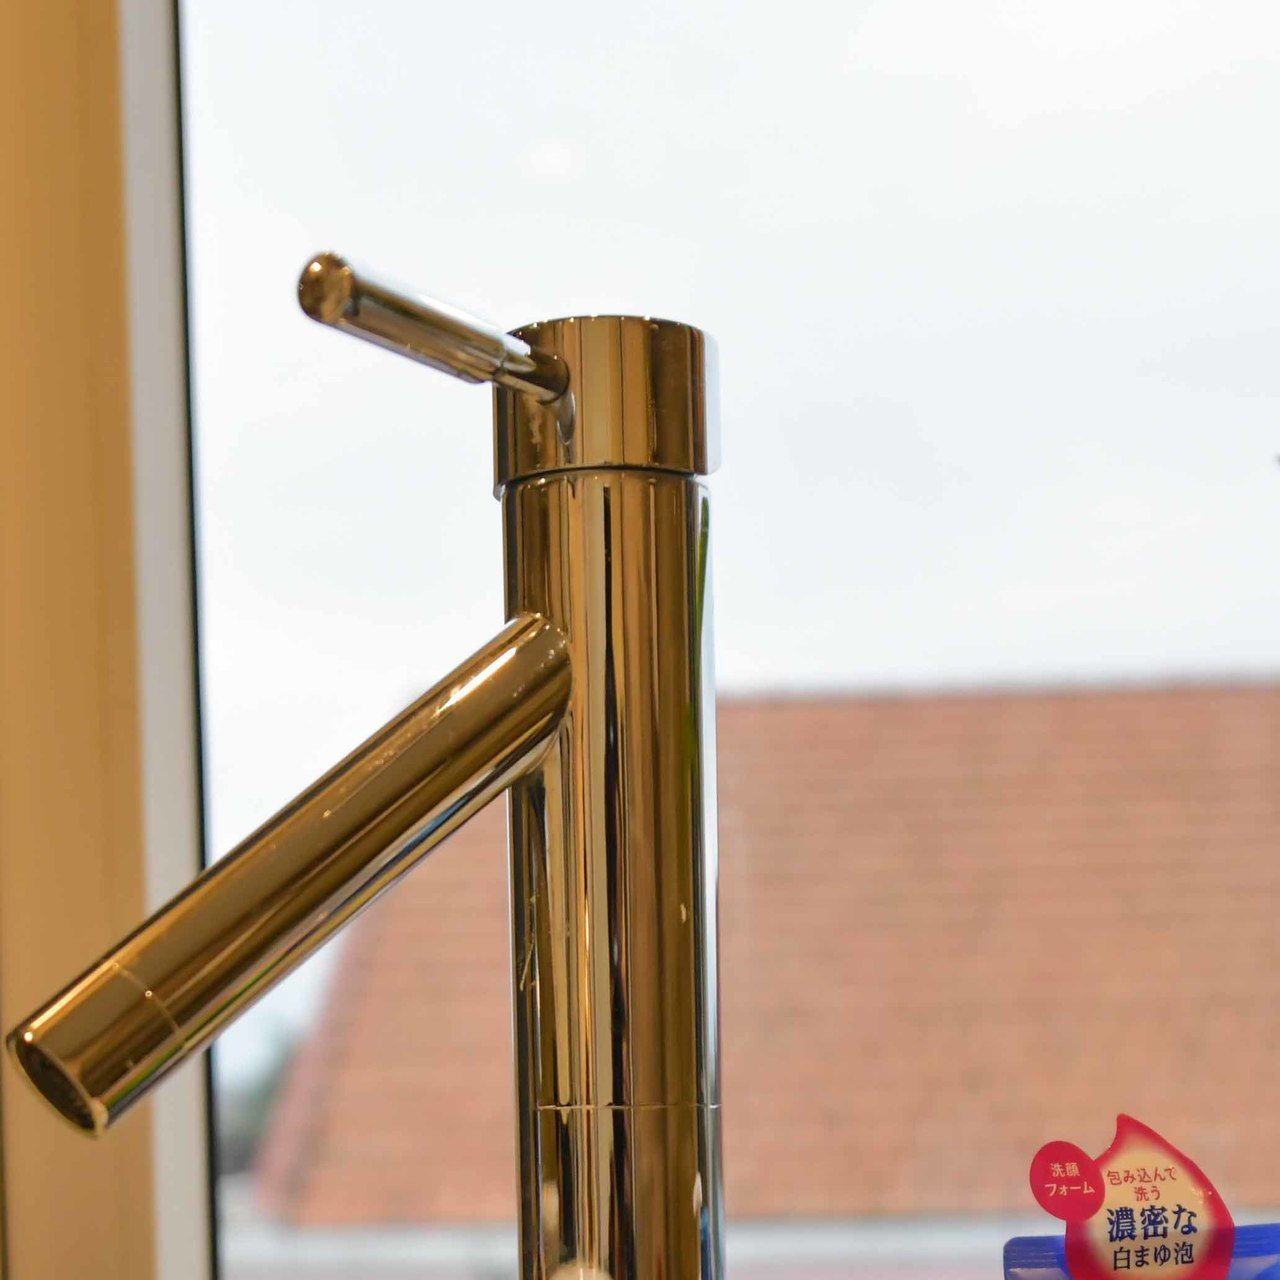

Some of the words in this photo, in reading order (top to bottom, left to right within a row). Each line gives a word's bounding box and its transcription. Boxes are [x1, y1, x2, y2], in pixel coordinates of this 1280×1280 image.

[1050, 1162, 1081, 1178] 洗顔
[1106, 1166, 1178, 1187] 包み込んで
[1044, 1181, 1096, 1197] フォーム
[1133, 1185, 1161, 1202] 洗う
[1106, 1204, 1199, 1243] 濃密な
[1112, 1241, 1195, 1271] 白まゆ泡
